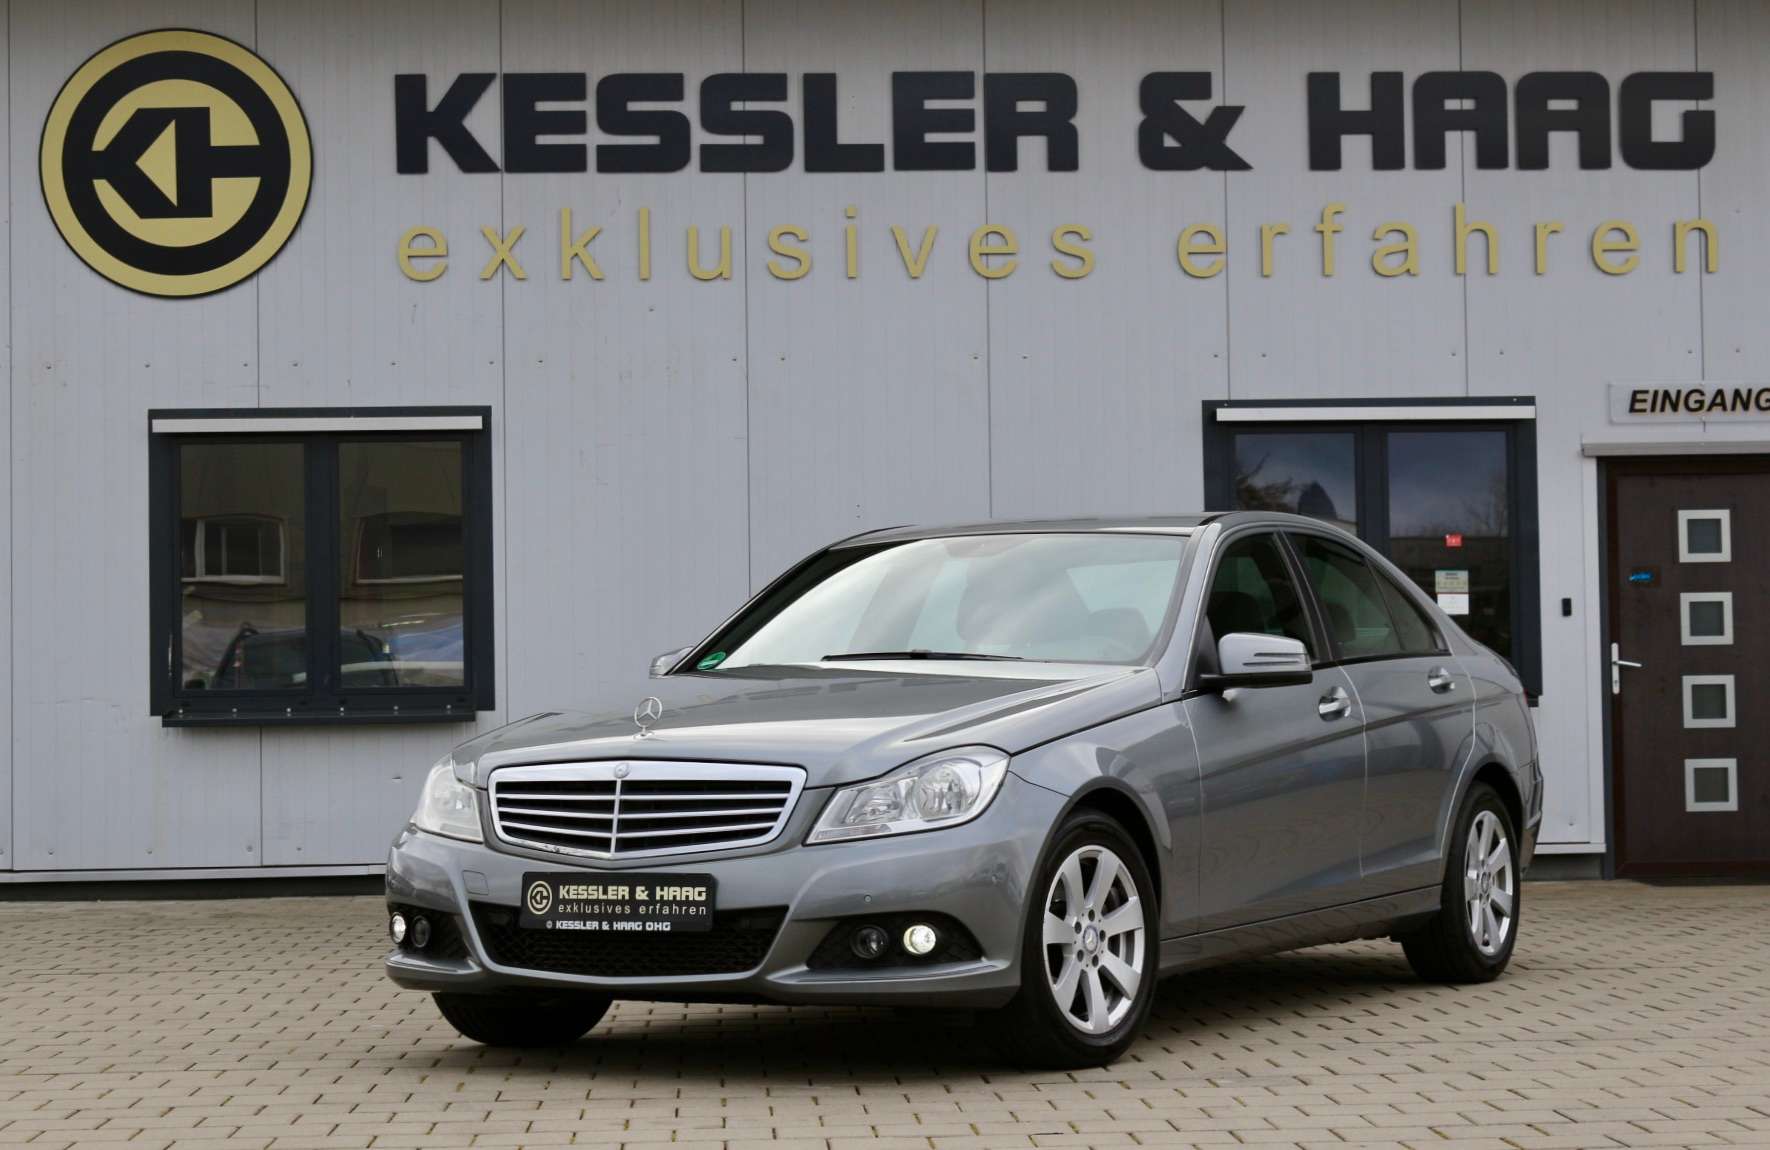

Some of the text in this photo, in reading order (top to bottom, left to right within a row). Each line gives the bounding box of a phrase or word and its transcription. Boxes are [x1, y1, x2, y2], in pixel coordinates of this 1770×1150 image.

[394, 71, 1716, 175] KESSLER & HAAG
[398, 203, 1720, 283] exklusives erfahren
[559, 885, 707, 901] KESSLER & HAAG
[558, 902, 707, 915] exklusives erfahren
[555, 920, 599, 930] KESSLER
[601, 921, 610, 930] &
[613, 922, 643, 931] HAAG
[645, 922, 671, 931] OHG
